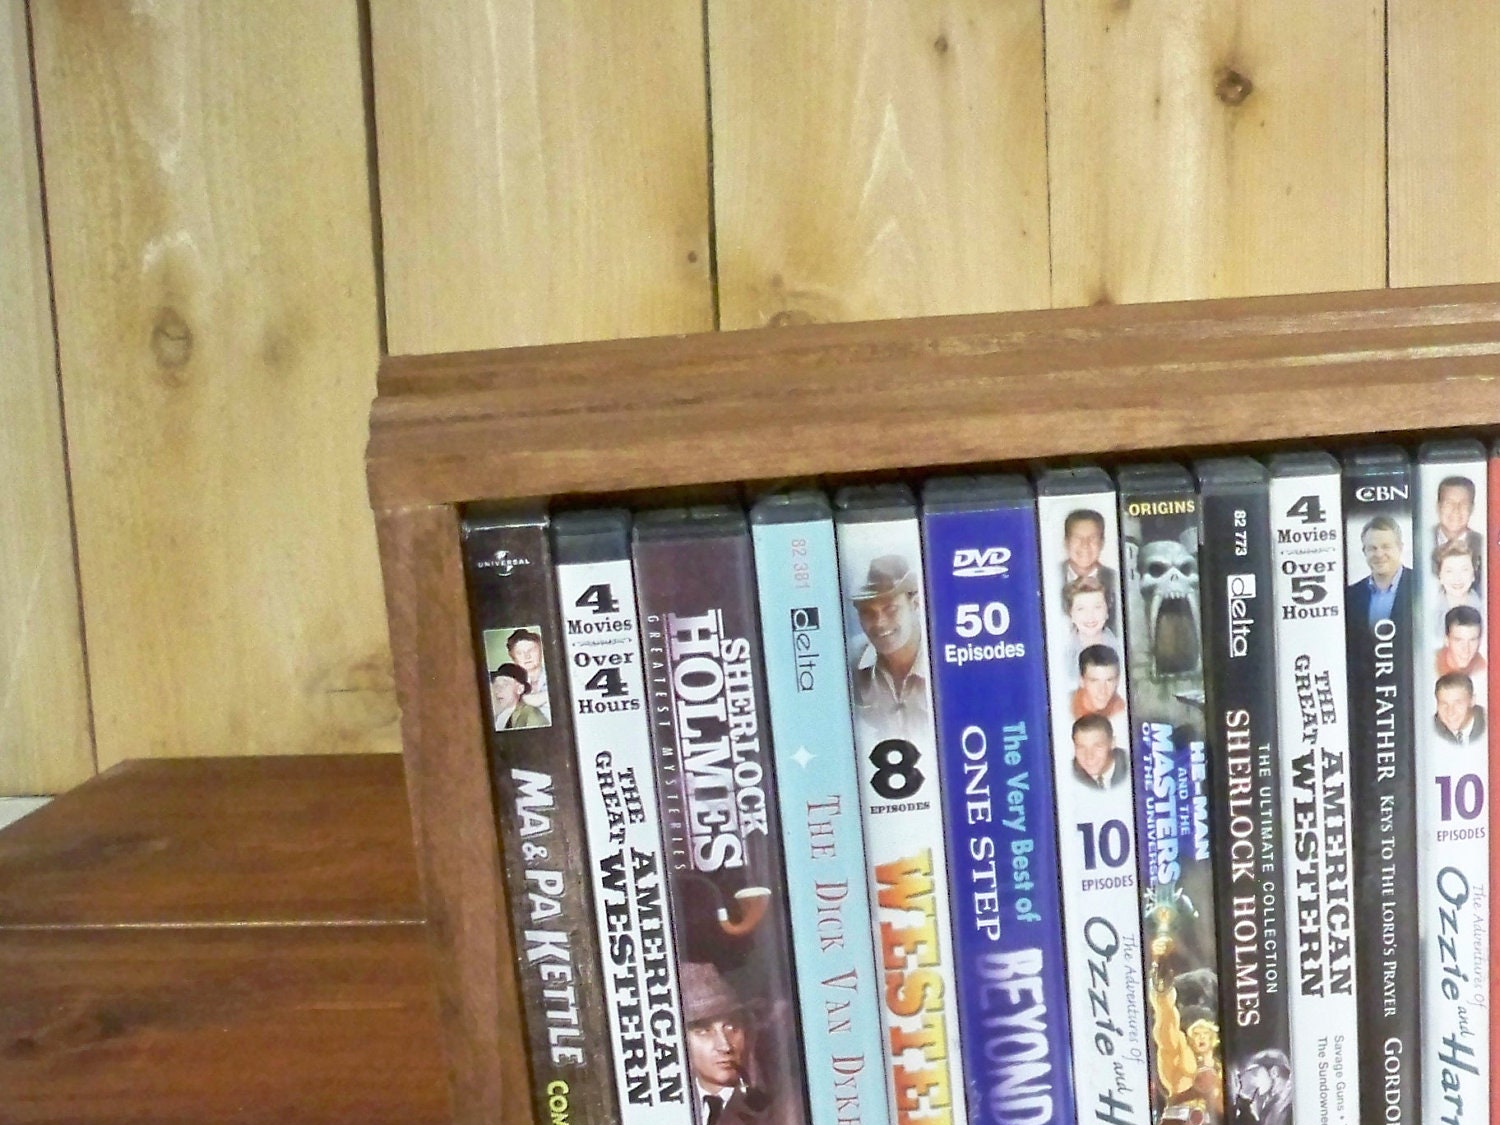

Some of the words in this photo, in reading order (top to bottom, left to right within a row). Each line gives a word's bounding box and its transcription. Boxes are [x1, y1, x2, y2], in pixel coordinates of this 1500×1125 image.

[1129, 500, 1195, 517] ORIGINS
[1286, 495, 1326, 525] 4
[1355, 484, 1410, 502] CBN
[477, 557, 530, 569] UNIVERSAL
[953, 548, 1011, 567] DVD
[1277, 527, 1337, 545] Movies
[1282, 559, 1336, 576] Over
[1290, 575, 1328, 605] 5
[568, 617, 632, 635] Movies
[575, 583, 620, 614] 4
[955, 602, 1010, 638] 50
[1227, 574, 1256, 658] delta
[1282, 604, 1339, 620] Hours
[574, 652, 635, 668] Over
[790, 607, 820, 693] delta
[945, 643, 1025, 666] Episodes
[1374, 619, 1397, 679] OUR
[578, 698, 640, 714] Hours
[584, 667, 630, 698] 4
[1294, 653, 1319, 747] GREAT
[1314, 670, 1338, 725] THE
[647, 614, 672, 728] GREATEST
[661, 747, 686, 871] MYSTERIES
[667, 608, 747, 872] HOLMES
[720, 638, 768, 836] SHERLOCK
[1002, 721, 1028, 766] The
[1257, 742, 1272, 777] THE
[1375, 685, 1397, 783] FATHER
[618, 767, 646, 825] THE
[869, 739, 926, 799] 8
[961, 725, 992, 825] ONE
[1177, 767, 1189, 801] AND
[1226, 710, 1256, 883] SHERLOCK
[511, 768, 552, 838] MA
[595, 750, 626, 846] GREAT
[869, 801, 930, 814] EPISODES
[1002, 771, 1029, 832] Very
[1149, 722, 1181, 885] MASTERS
[1178, 805, 1191, 837] THE
[1189, 740, 1211, 861] HE-MAN
[1379, 795, 1396, 833] KEYS
[1434, 773, 1485, 822] 10
[521, 842, 548, 861] &
[807, 795, 842, 860] THE
[1076, 819, 1131, 871] 10
[1259, 788, 1275, 874] ULTIMATE
[1380, 836, 1396, 860] TO
[1436, 827, 1486, 842] EPISODES
[971, 837, 1001, 942] STEP
[1011, 838, 1035, 891] Best
[1081, 874, 1134, 892] EPISODES
[1291, 749, 1325, 998] WESTERN
[1320, 746, 1353, 997] AMERICAN
[1381, 863, 1397, 897] THE
[525, 869, 565, 922] PA
[814, 878, 848, 952] DICK
[1015, 897, 1041, 922] of
[1263, 881, 1279, 994] COLLECTION
[1381, 902, 1398, 957] LORD'S
[1436, 866, 1471, 1002] Ozzie
[1458, 1006, 1476, 1037] and
[600, 849, 654, 1107] WESTERN
[631, 847, 685, 1105] AMERICAN
[1232, 895, 1260, 1028] HOLMES
[1383, 960, 1398, 1018] PRAYER
[525, 930, 585, 1067] KETTLE
[822, 969, 858, 1034] VAN
[1083, 916, 1124, 1057] Ozzie
[1113, 1061, 1134, 1094] and
